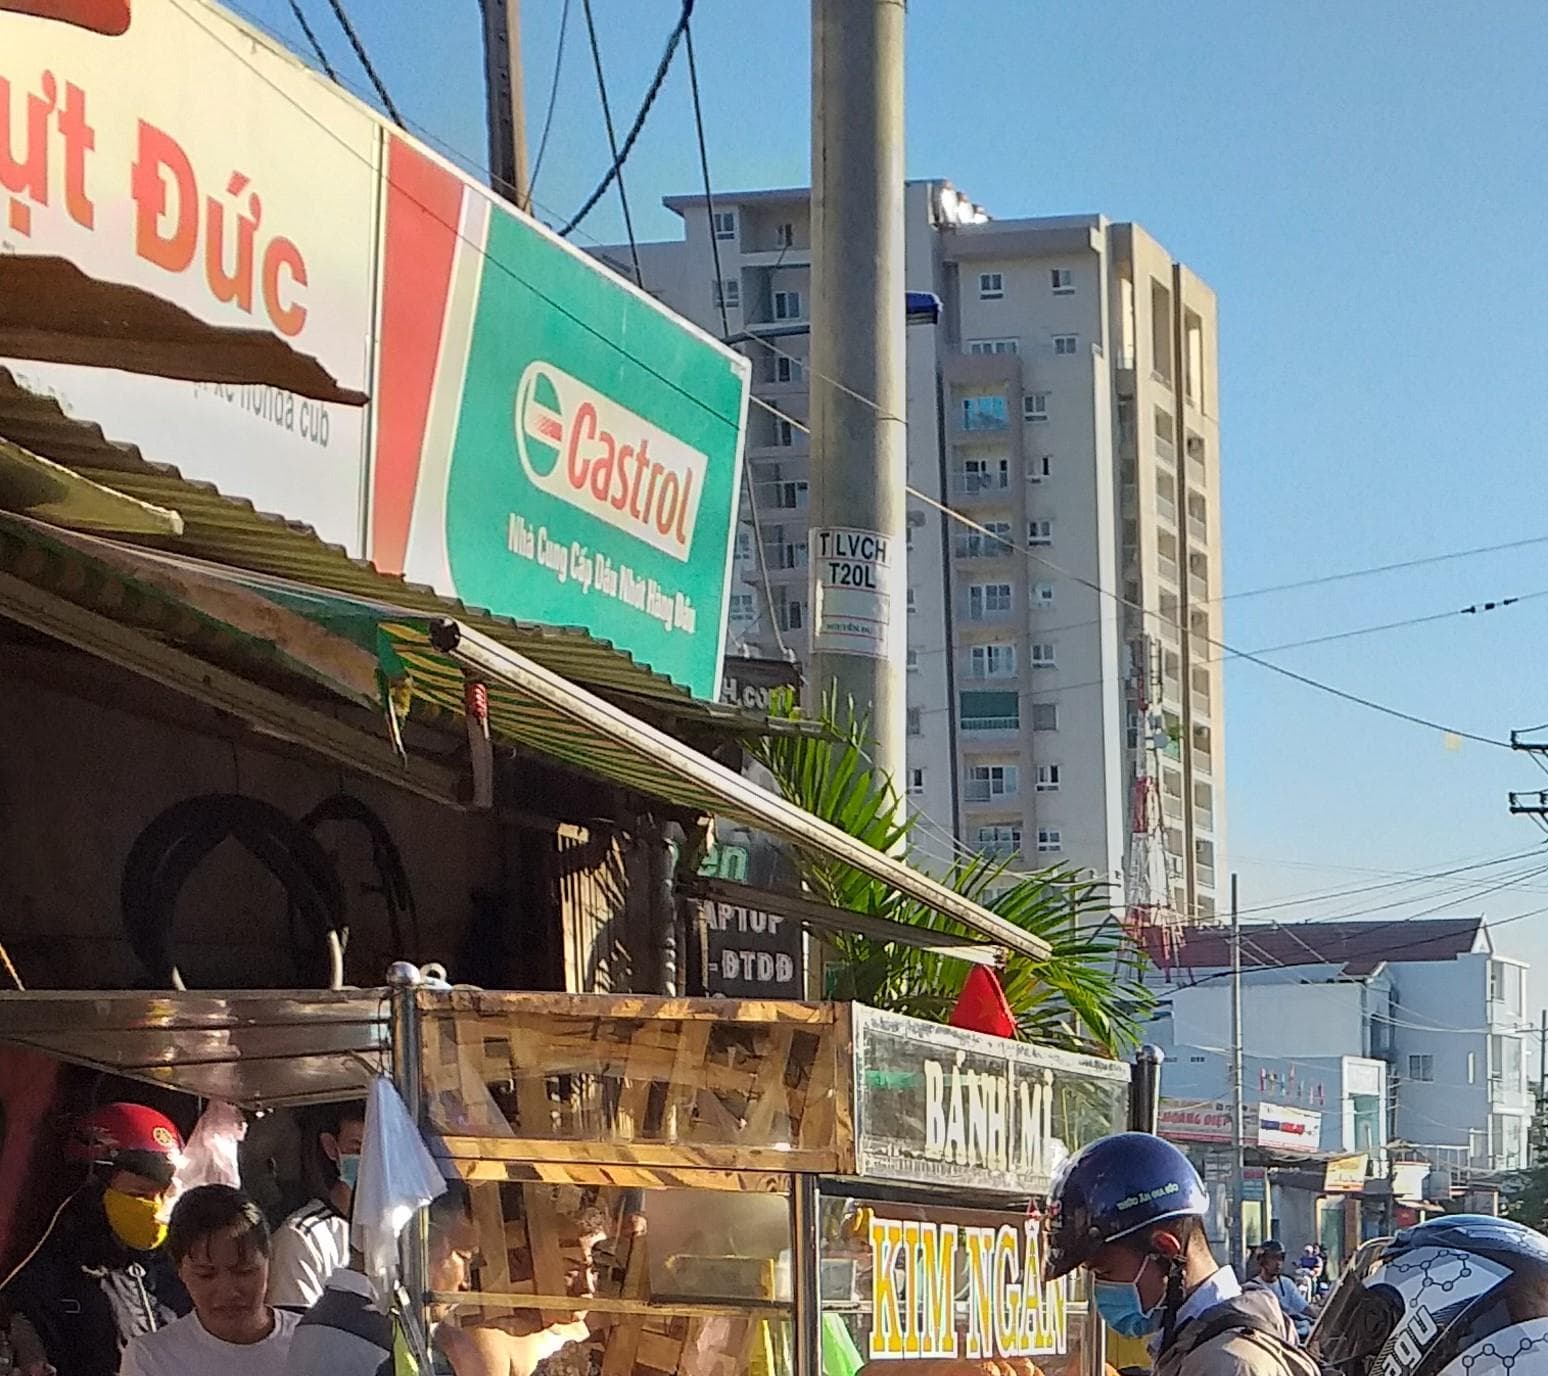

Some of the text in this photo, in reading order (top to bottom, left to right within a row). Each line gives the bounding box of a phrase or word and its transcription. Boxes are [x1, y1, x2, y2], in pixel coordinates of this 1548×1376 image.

[131, 118, 309, 337] Đức
[567, 402, 693, 545] Castrol
[828, 562, 877, 588] T20L
[869, 1218, 958, 1359] KIM
